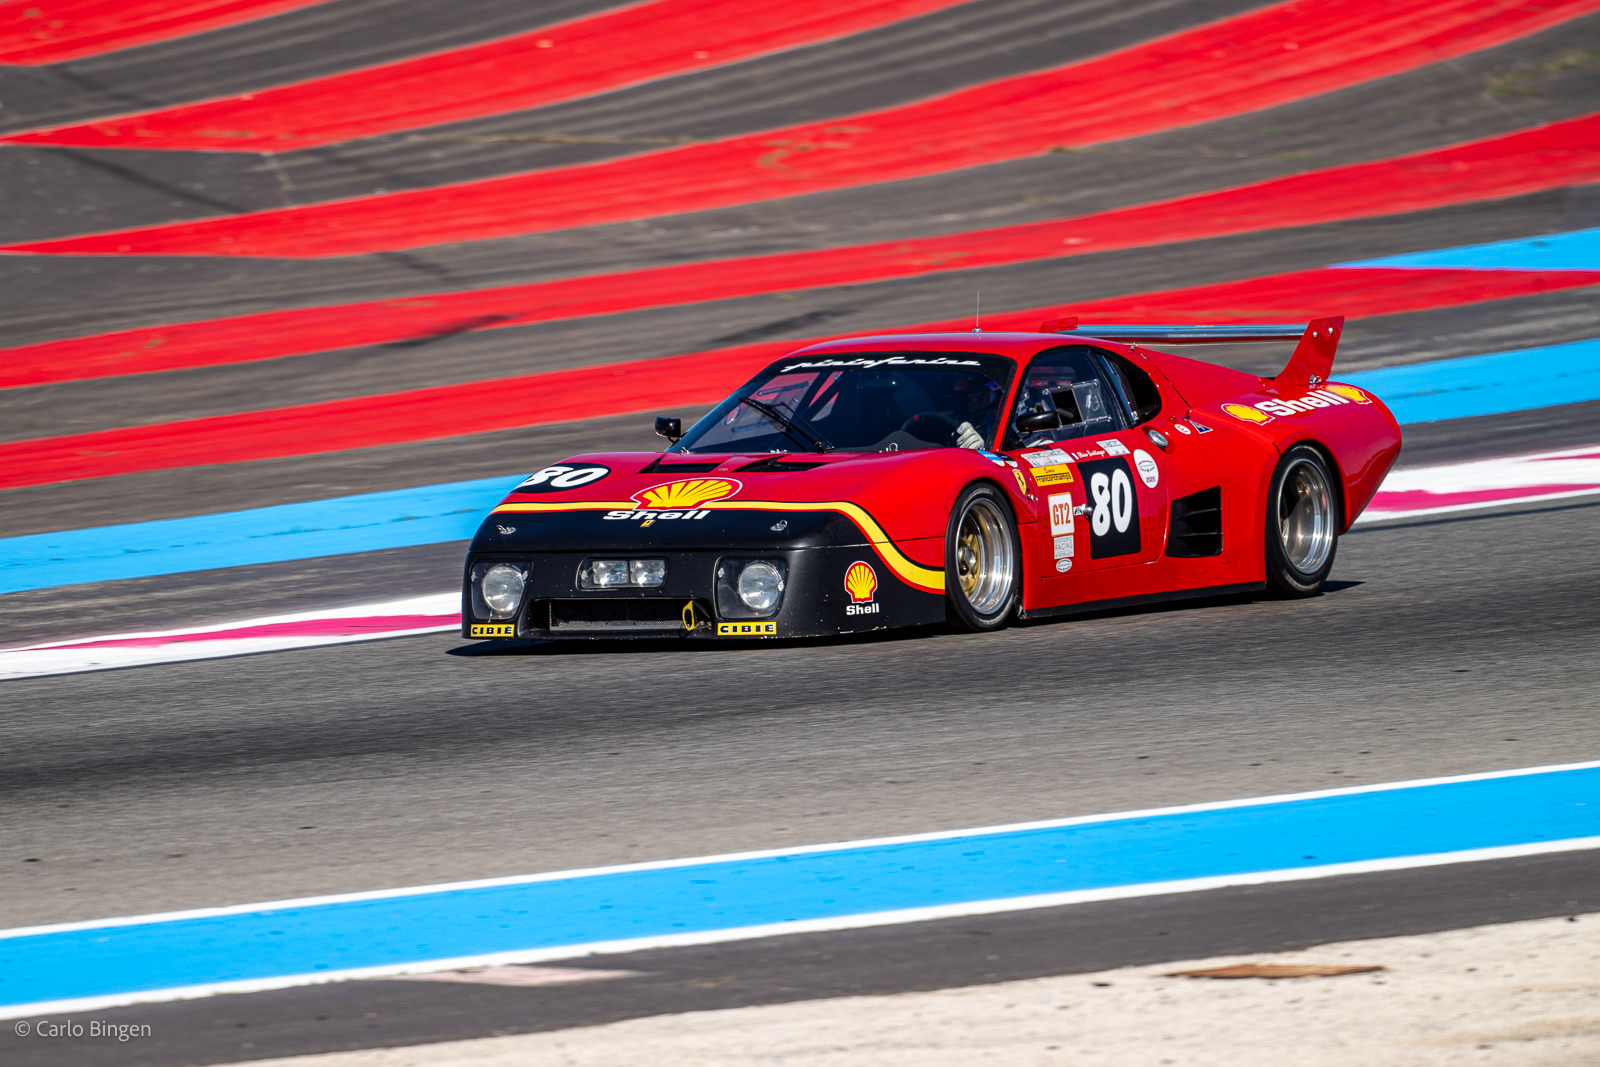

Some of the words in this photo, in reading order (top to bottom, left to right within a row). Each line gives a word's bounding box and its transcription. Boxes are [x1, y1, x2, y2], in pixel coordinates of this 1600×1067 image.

[780, 356, 981, 373] pininfarina
[1254, 389, 1351, 417] Shell
[514, 466, 609, 488] 80
[1091, 468, 1132, 537] 80
[602, 509, 712, 520] Shell
[1052, 502, 1071, 526] GT2
[846, 603, 880, 616] Shell
